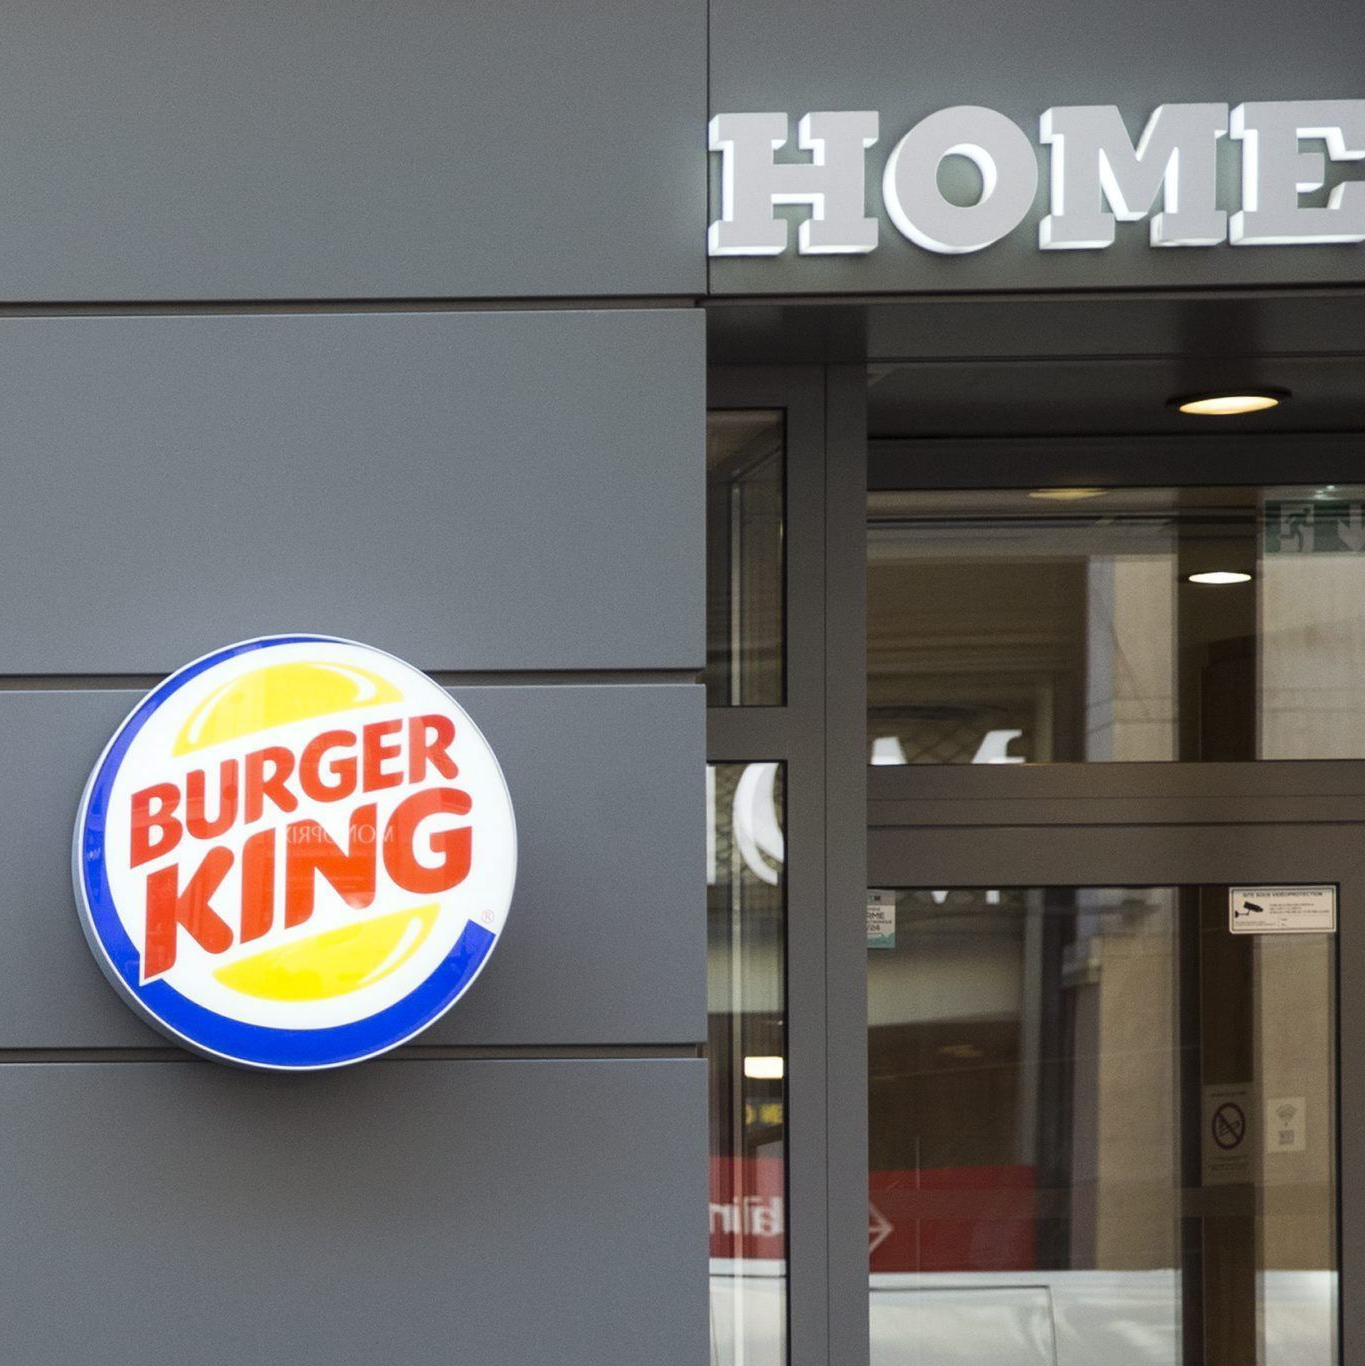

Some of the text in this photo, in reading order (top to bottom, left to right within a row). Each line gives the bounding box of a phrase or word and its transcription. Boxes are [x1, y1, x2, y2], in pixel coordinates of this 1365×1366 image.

[708, 99, 1365, 256] HOME
[129, 714, 460, 869] BURGER
[144, 787, 473, 980] KING
